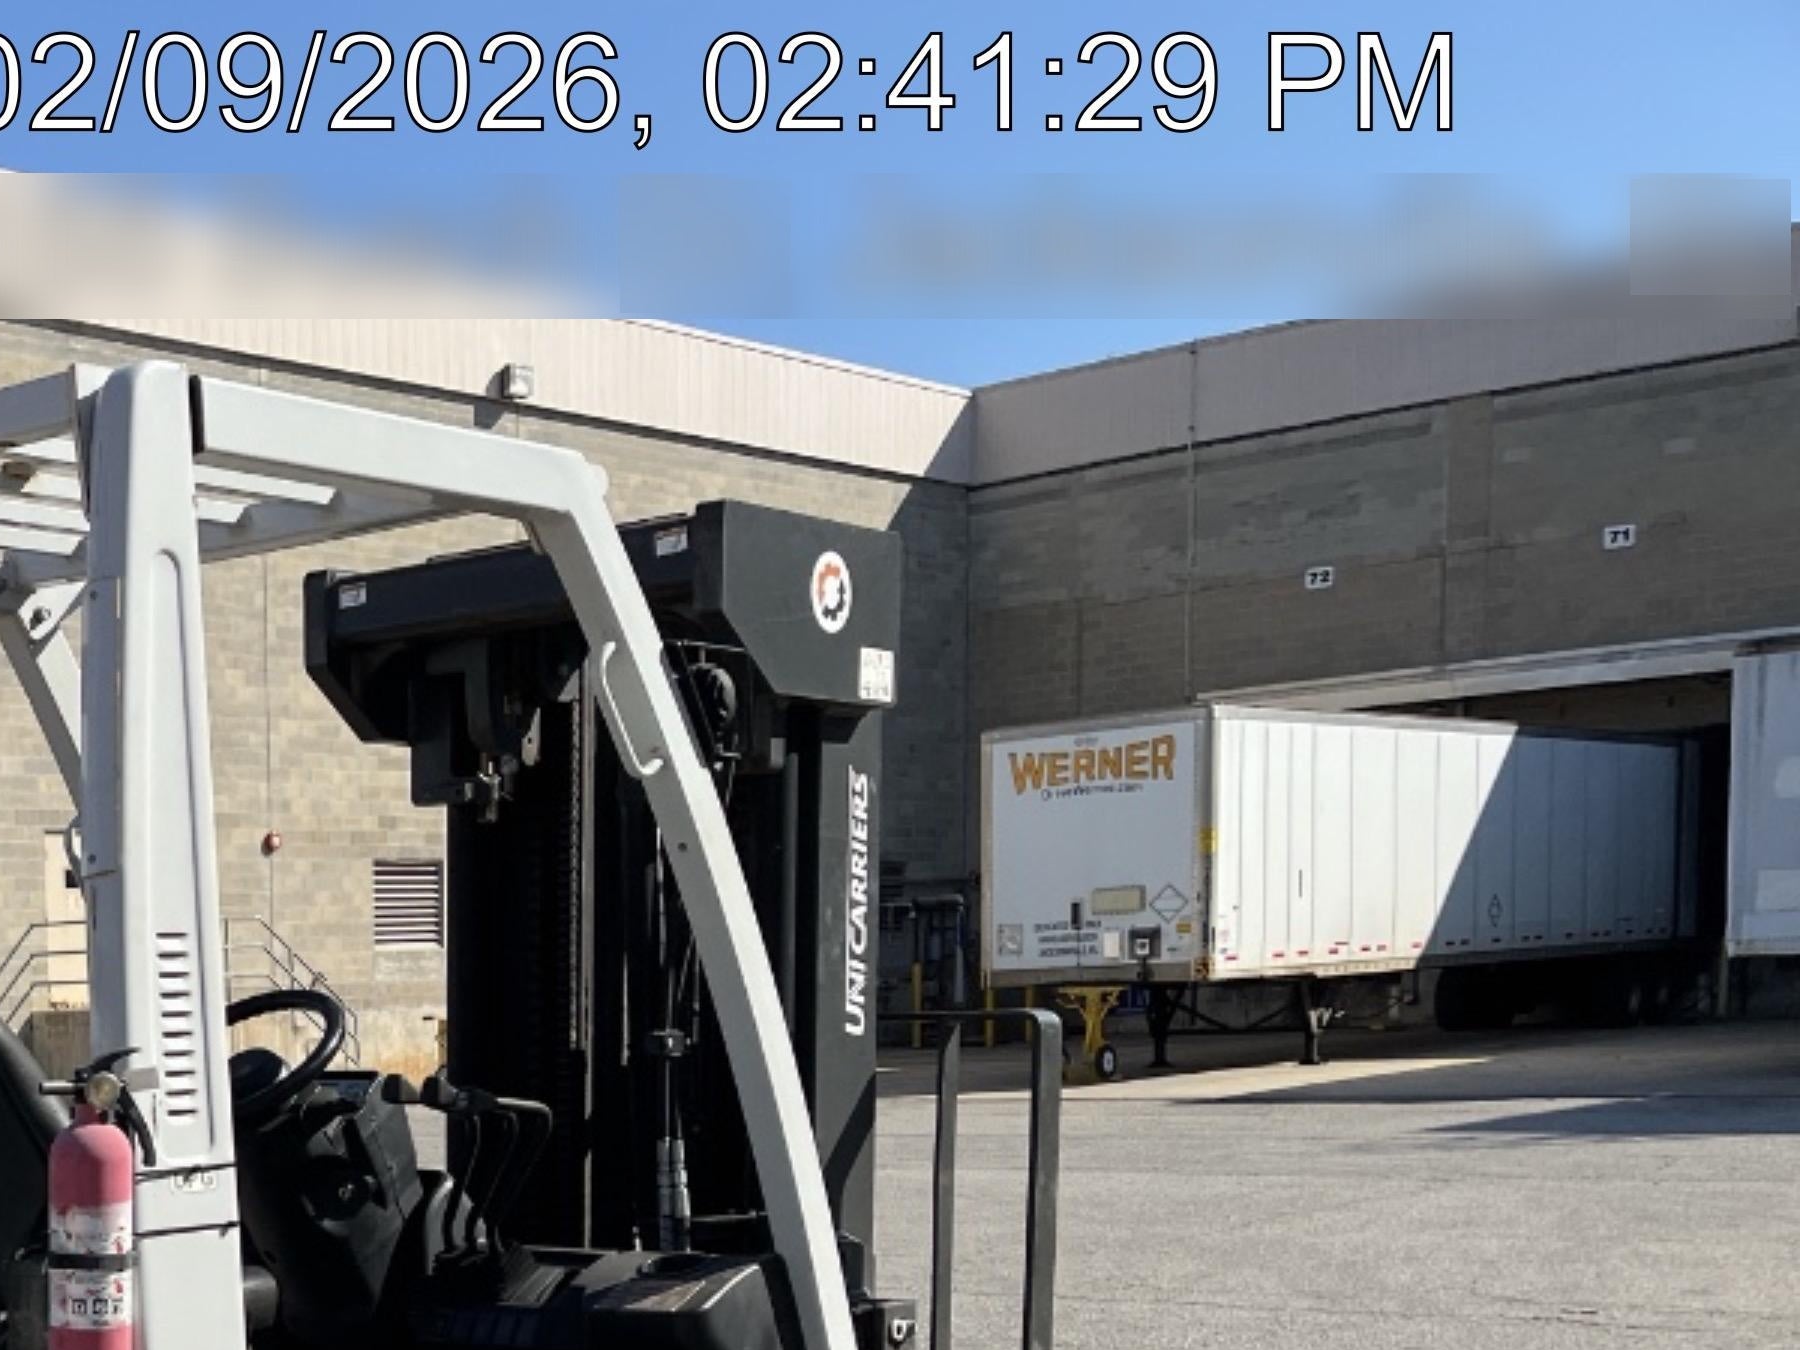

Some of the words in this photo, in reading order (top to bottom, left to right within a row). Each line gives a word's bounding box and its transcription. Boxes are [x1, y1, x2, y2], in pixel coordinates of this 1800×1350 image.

[1608, 527, 1631, 544] 71
[1308, 570, 1331, 585] 72
[1007, 734, 1177, 796] WERNER
